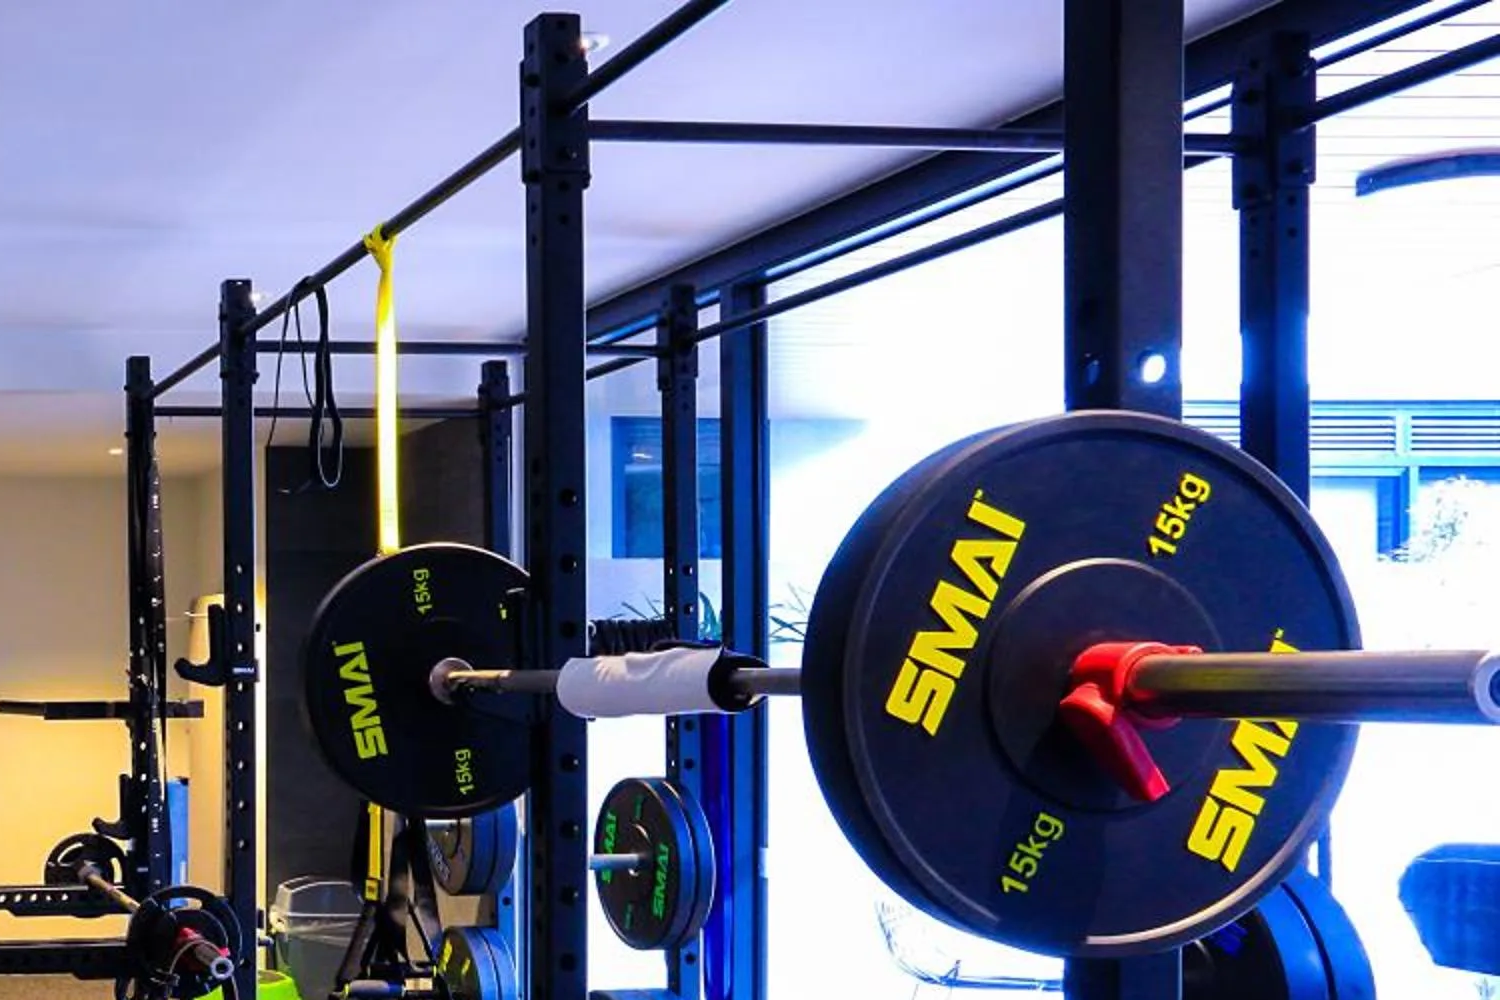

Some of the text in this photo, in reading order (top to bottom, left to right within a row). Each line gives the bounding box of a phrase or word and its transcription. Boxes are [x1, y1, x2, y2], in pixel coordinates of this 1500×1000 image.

[1148, 472, 1212, 557] 15kg
[414, 569, 432, 615] 15kg
[885, 498, 1027, 737] SMAI
[334, 641, 389, 760] SMAI
[455, 748, 475, 795] 15kg
[1187, 639, 1300, 872] SM
[1000, 811, 1064, 892] 15kg
